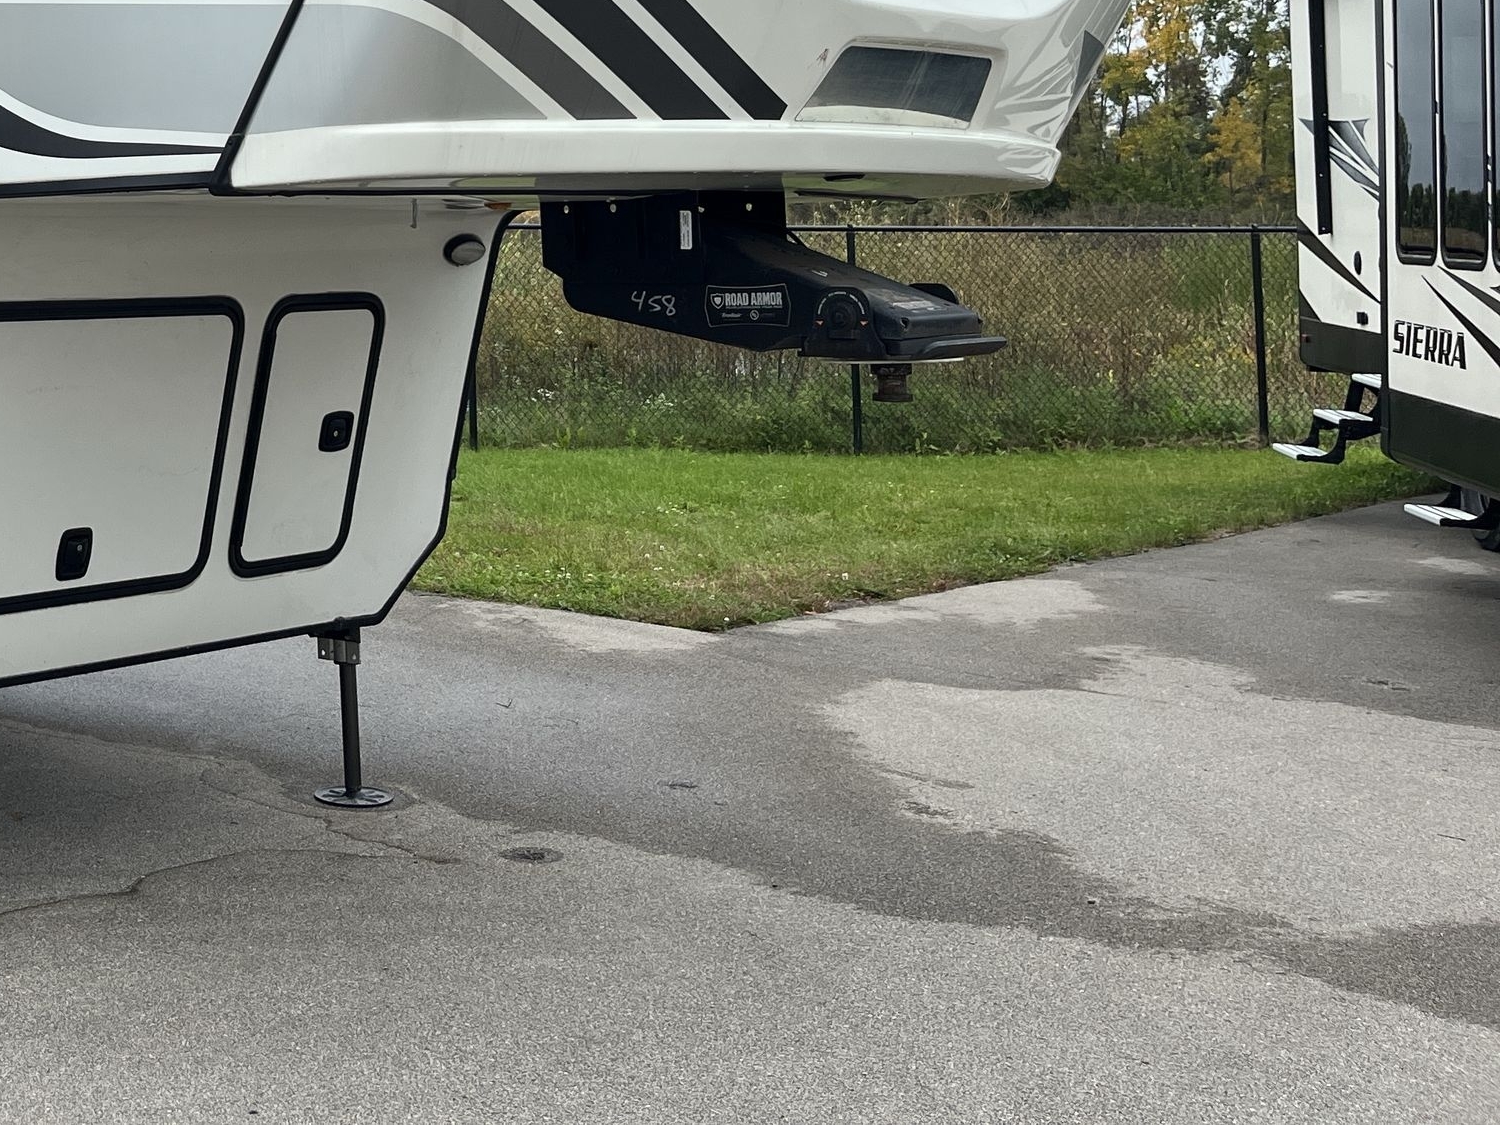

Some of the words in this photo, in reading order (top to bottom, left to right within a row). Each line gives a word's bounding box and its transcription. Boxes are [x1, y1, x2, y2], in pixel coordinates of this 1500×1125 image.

[631, 290, 676, 316] 458
[725, 292, 749, 306] ROAD
[751, 292, 782, 306] ARMOR
[1392, 319, 1467, 370] SIERRA
